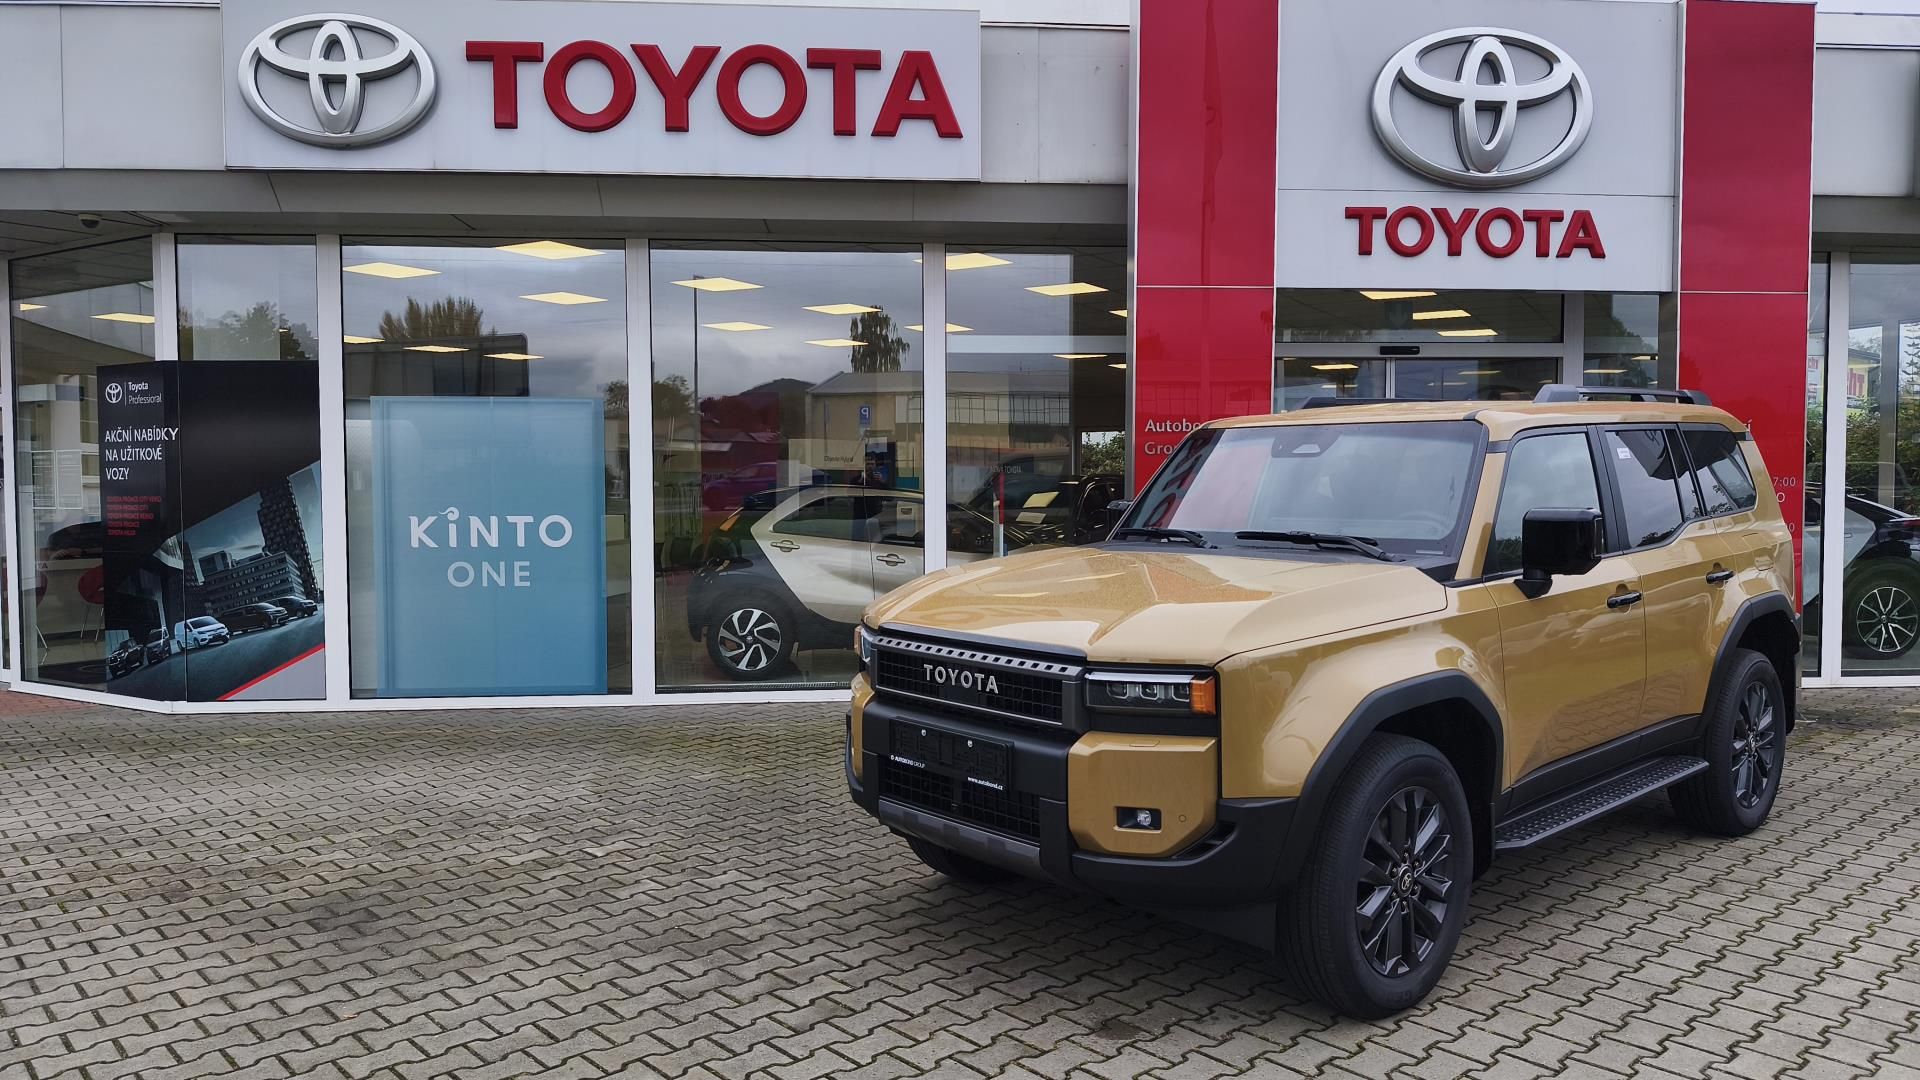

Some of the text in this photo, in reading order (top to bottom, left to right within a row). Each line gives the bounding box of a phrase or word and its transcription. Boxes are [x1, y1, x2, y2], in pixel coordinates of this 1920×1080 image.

[465, 39, 964, 139] TOYOTA
[1345, 205, 1606, 259] TOYOTA
[128, 382, 149, 393] Toyota
[128, 392, 162, 404] Professional
[105, 425, 179, 442] AKČNÍ NABÍDKY
[105, 444, 163, 461] NA UŽITKOVÉ
[1144, 441, 1177, 455] Gro
[105, 467, 130, 480] VOZY
[447, 560, 531, 588] ONE
[923, 663, 999, 694] TOYOTA
